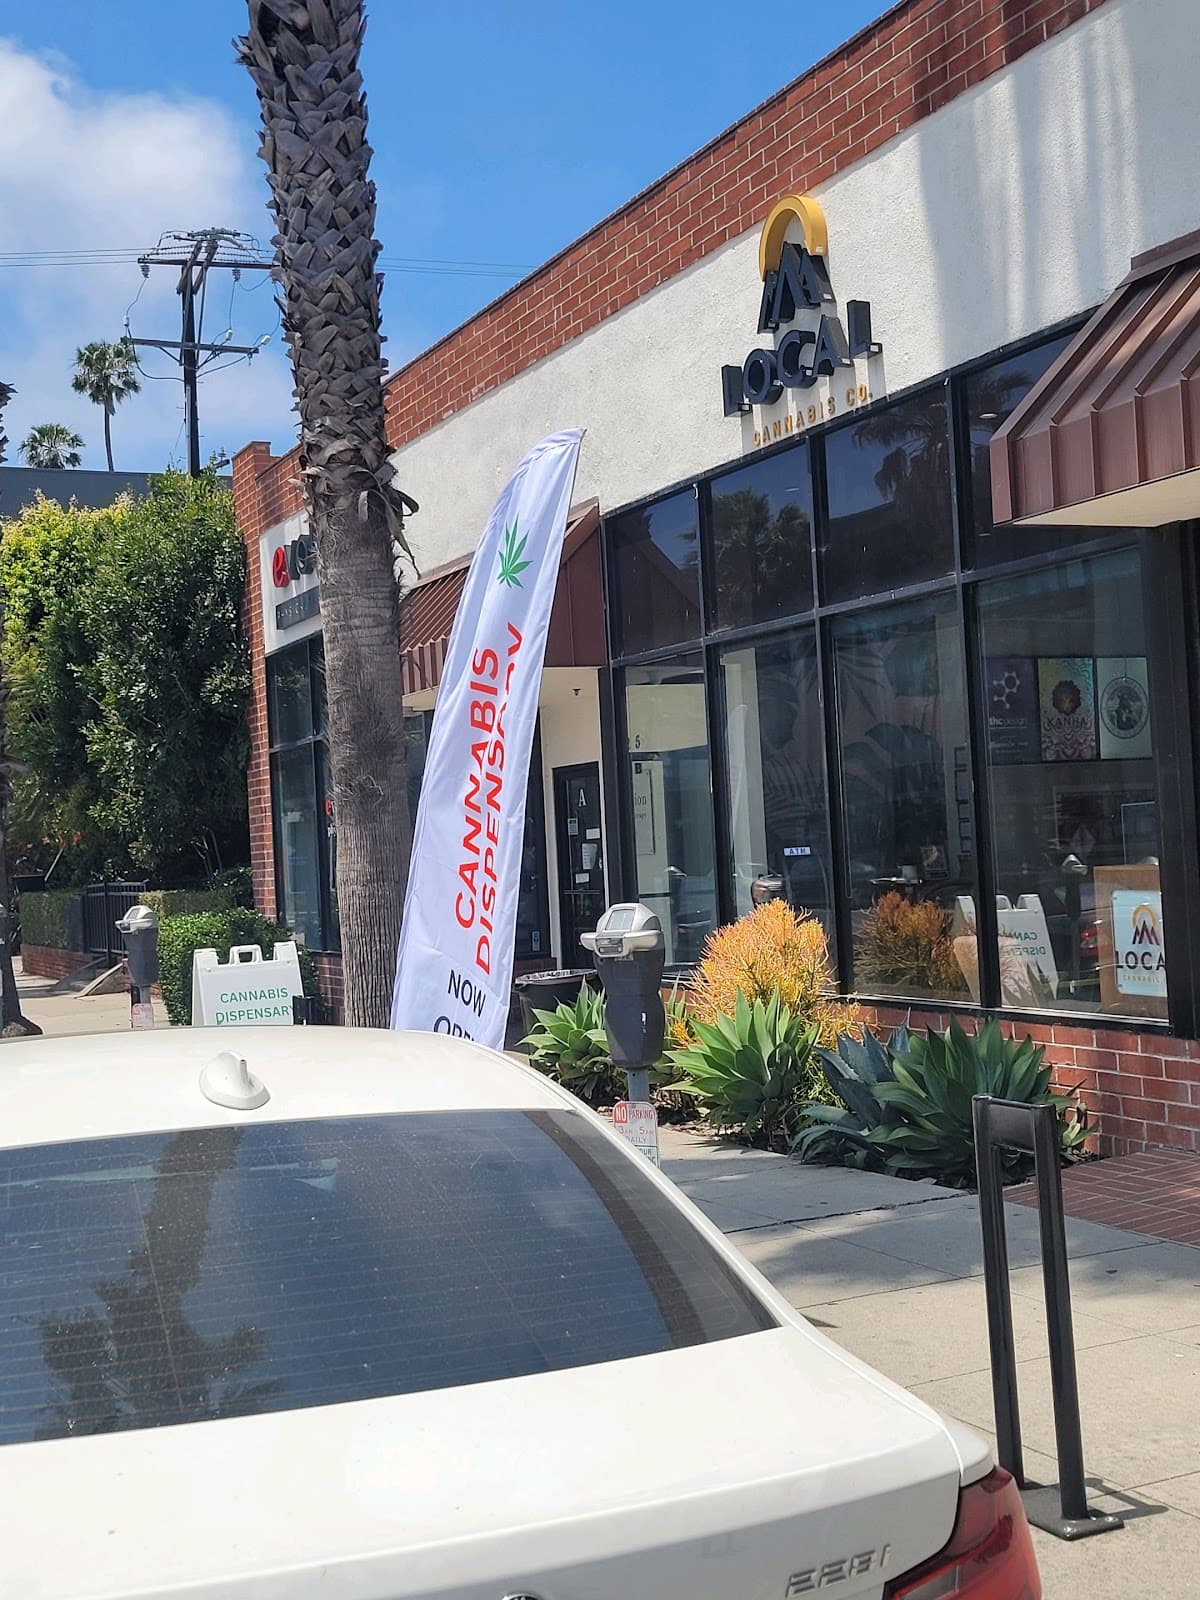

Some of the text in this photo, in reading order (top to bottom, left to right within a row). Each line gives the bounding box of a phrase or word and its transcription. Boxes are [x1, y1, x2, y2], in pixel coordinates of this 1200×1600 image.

[721, 299, 883, 417] LOCAL
[752, 383, 873, 447] CANNABIS CO.
[455, 648, 499, 929] CANNABIS
[578, 788, 587, 807] A
[1115, 951, 1166, 971] LOCA
[220, 987, 289, 1003] CANNABIS
[447, 969, 487, 1018] NOW
[215, 1005, 293, 1025] DISPENSAR
[433, 1015, 475, 1042] OP
[616, 1106, 653, 1121] NO PARKING
